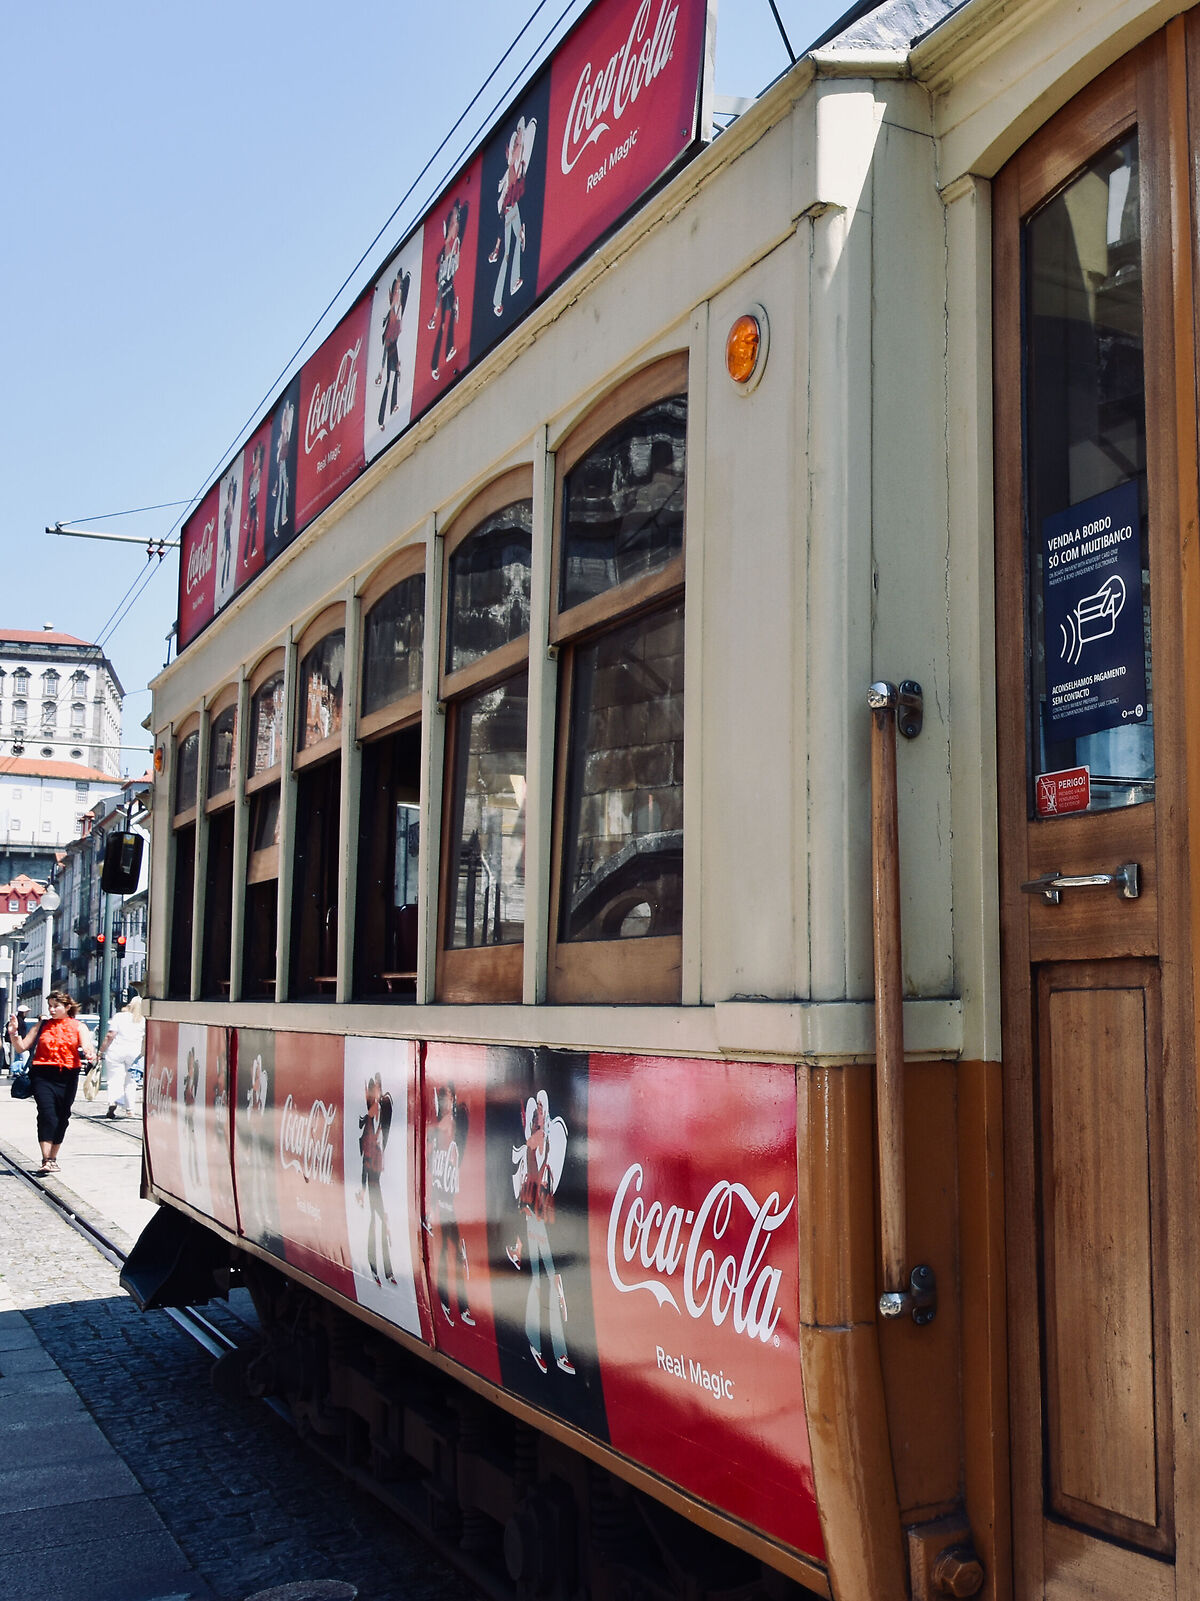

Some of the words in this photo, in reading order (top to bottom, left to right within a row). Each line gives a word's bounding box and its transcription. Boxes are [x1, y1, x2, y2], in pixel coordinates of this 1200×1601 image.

[561, 0, 679, 175] Coca-Cola
[586, 159, 607, 193] Real
[608, 130, 638, 170] Magic
[304, 334, 363, 454] Coca-Cola
[1047, 531, 1074, 551] VENDA
[1074, 528, 1081, 541] A
[1082, 516, 1111, 538] BORDO
[1048, 552, 1059, 569] SÓ
[1060, 546, 1080, 563] COM
[1081, 526, 1132, 556] MULTIBANCO
[1051, 676, 1093, 695] ACONSELHAMOS
[1093, 666, 1127, 682] PAGAMENTO
[1052, 696, 1063, 706] SEM
[1063, 688, 1090, 703] CONTACTO
[1058, 776, 1086, 789] PERIGO!
[280, 1094, 336, 1184] Coca-Cola
[607, 1163, 795, 1343] Coca-Cola
[656, 1345, 686, 1380] Real
[689, 1359, 734, 1400] Magic
